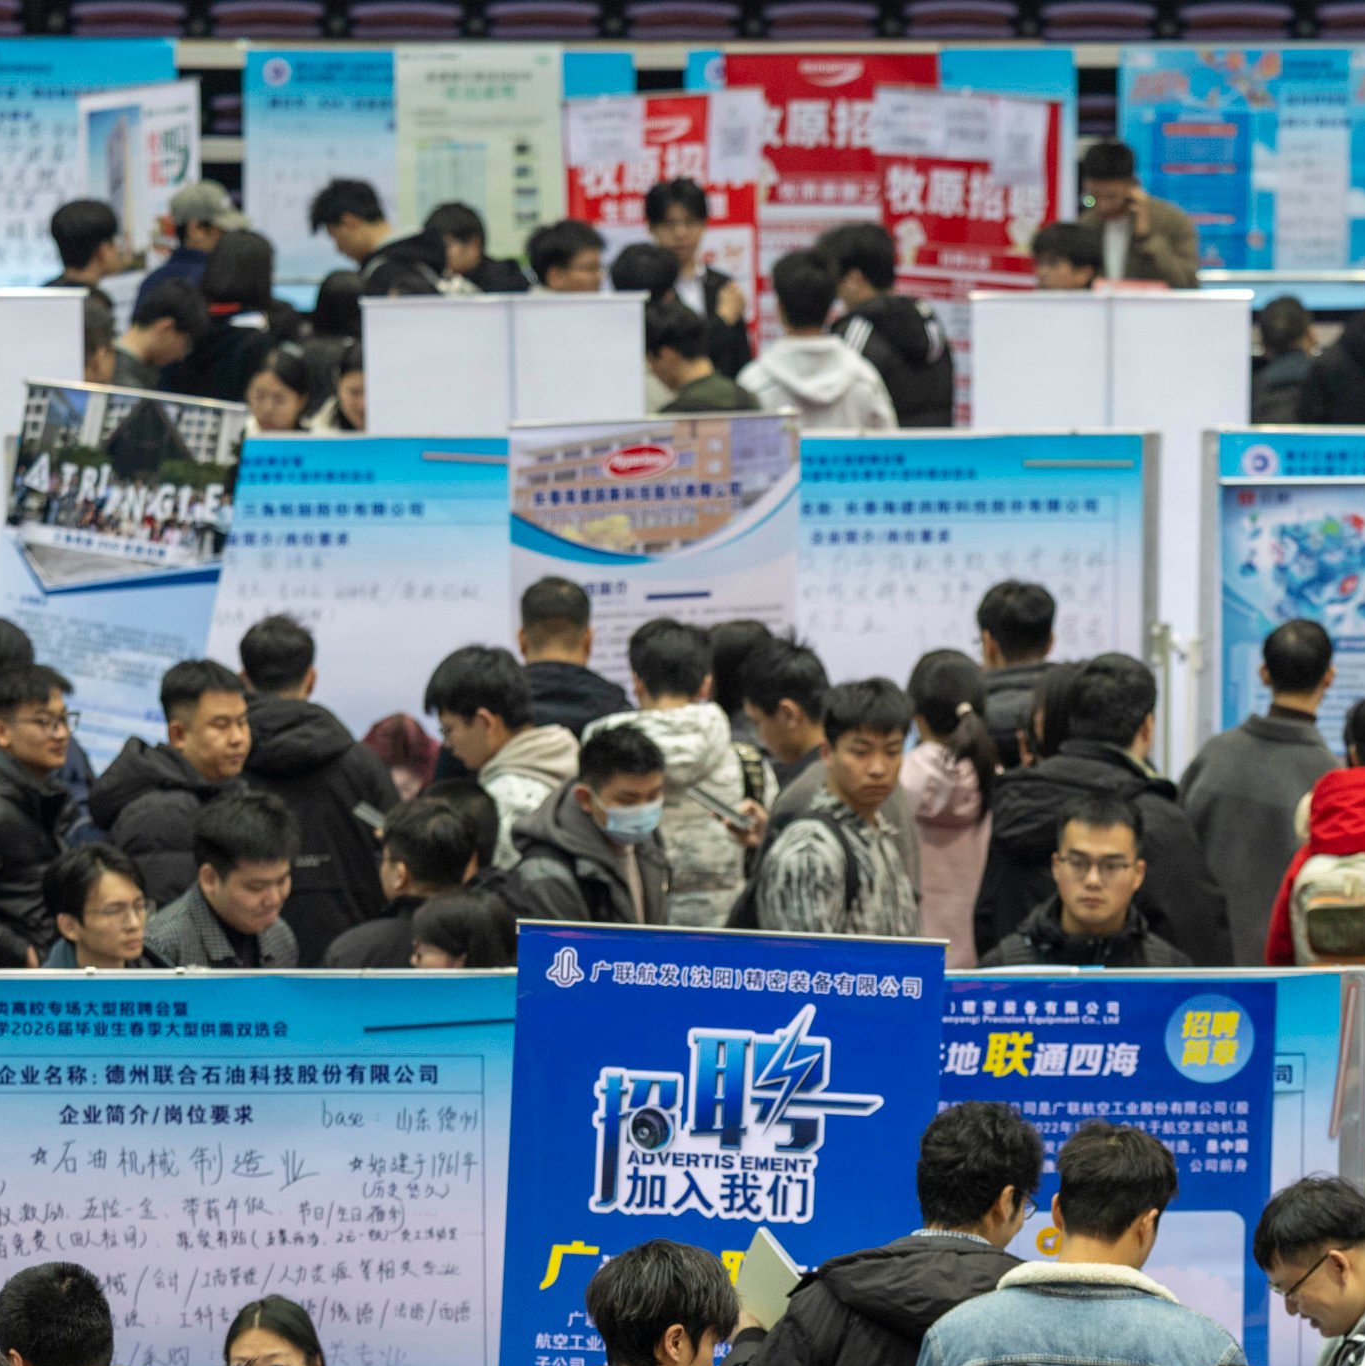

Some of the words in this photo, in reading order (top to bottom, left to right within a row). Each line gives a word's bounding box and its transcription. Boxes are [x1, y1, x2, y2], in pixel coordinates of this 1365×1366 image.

[590, 960, 925, 1000] 广联航发(沈阳)精密装备有限公司
[1181, 1010, 1241, 1039] 招聘
[939, 1031, 1142, 1079] 地联通四海
[1181, 1039, 1240, 1067] 简章
[58, 1104, 255, 1127] 企业简介/岗位要求
[590, 1003, 885, 1214] 招聘
[52, 1139, 321, 1193] 石油机械制造业
[623, 1168, 811, 1218] 加入我们
